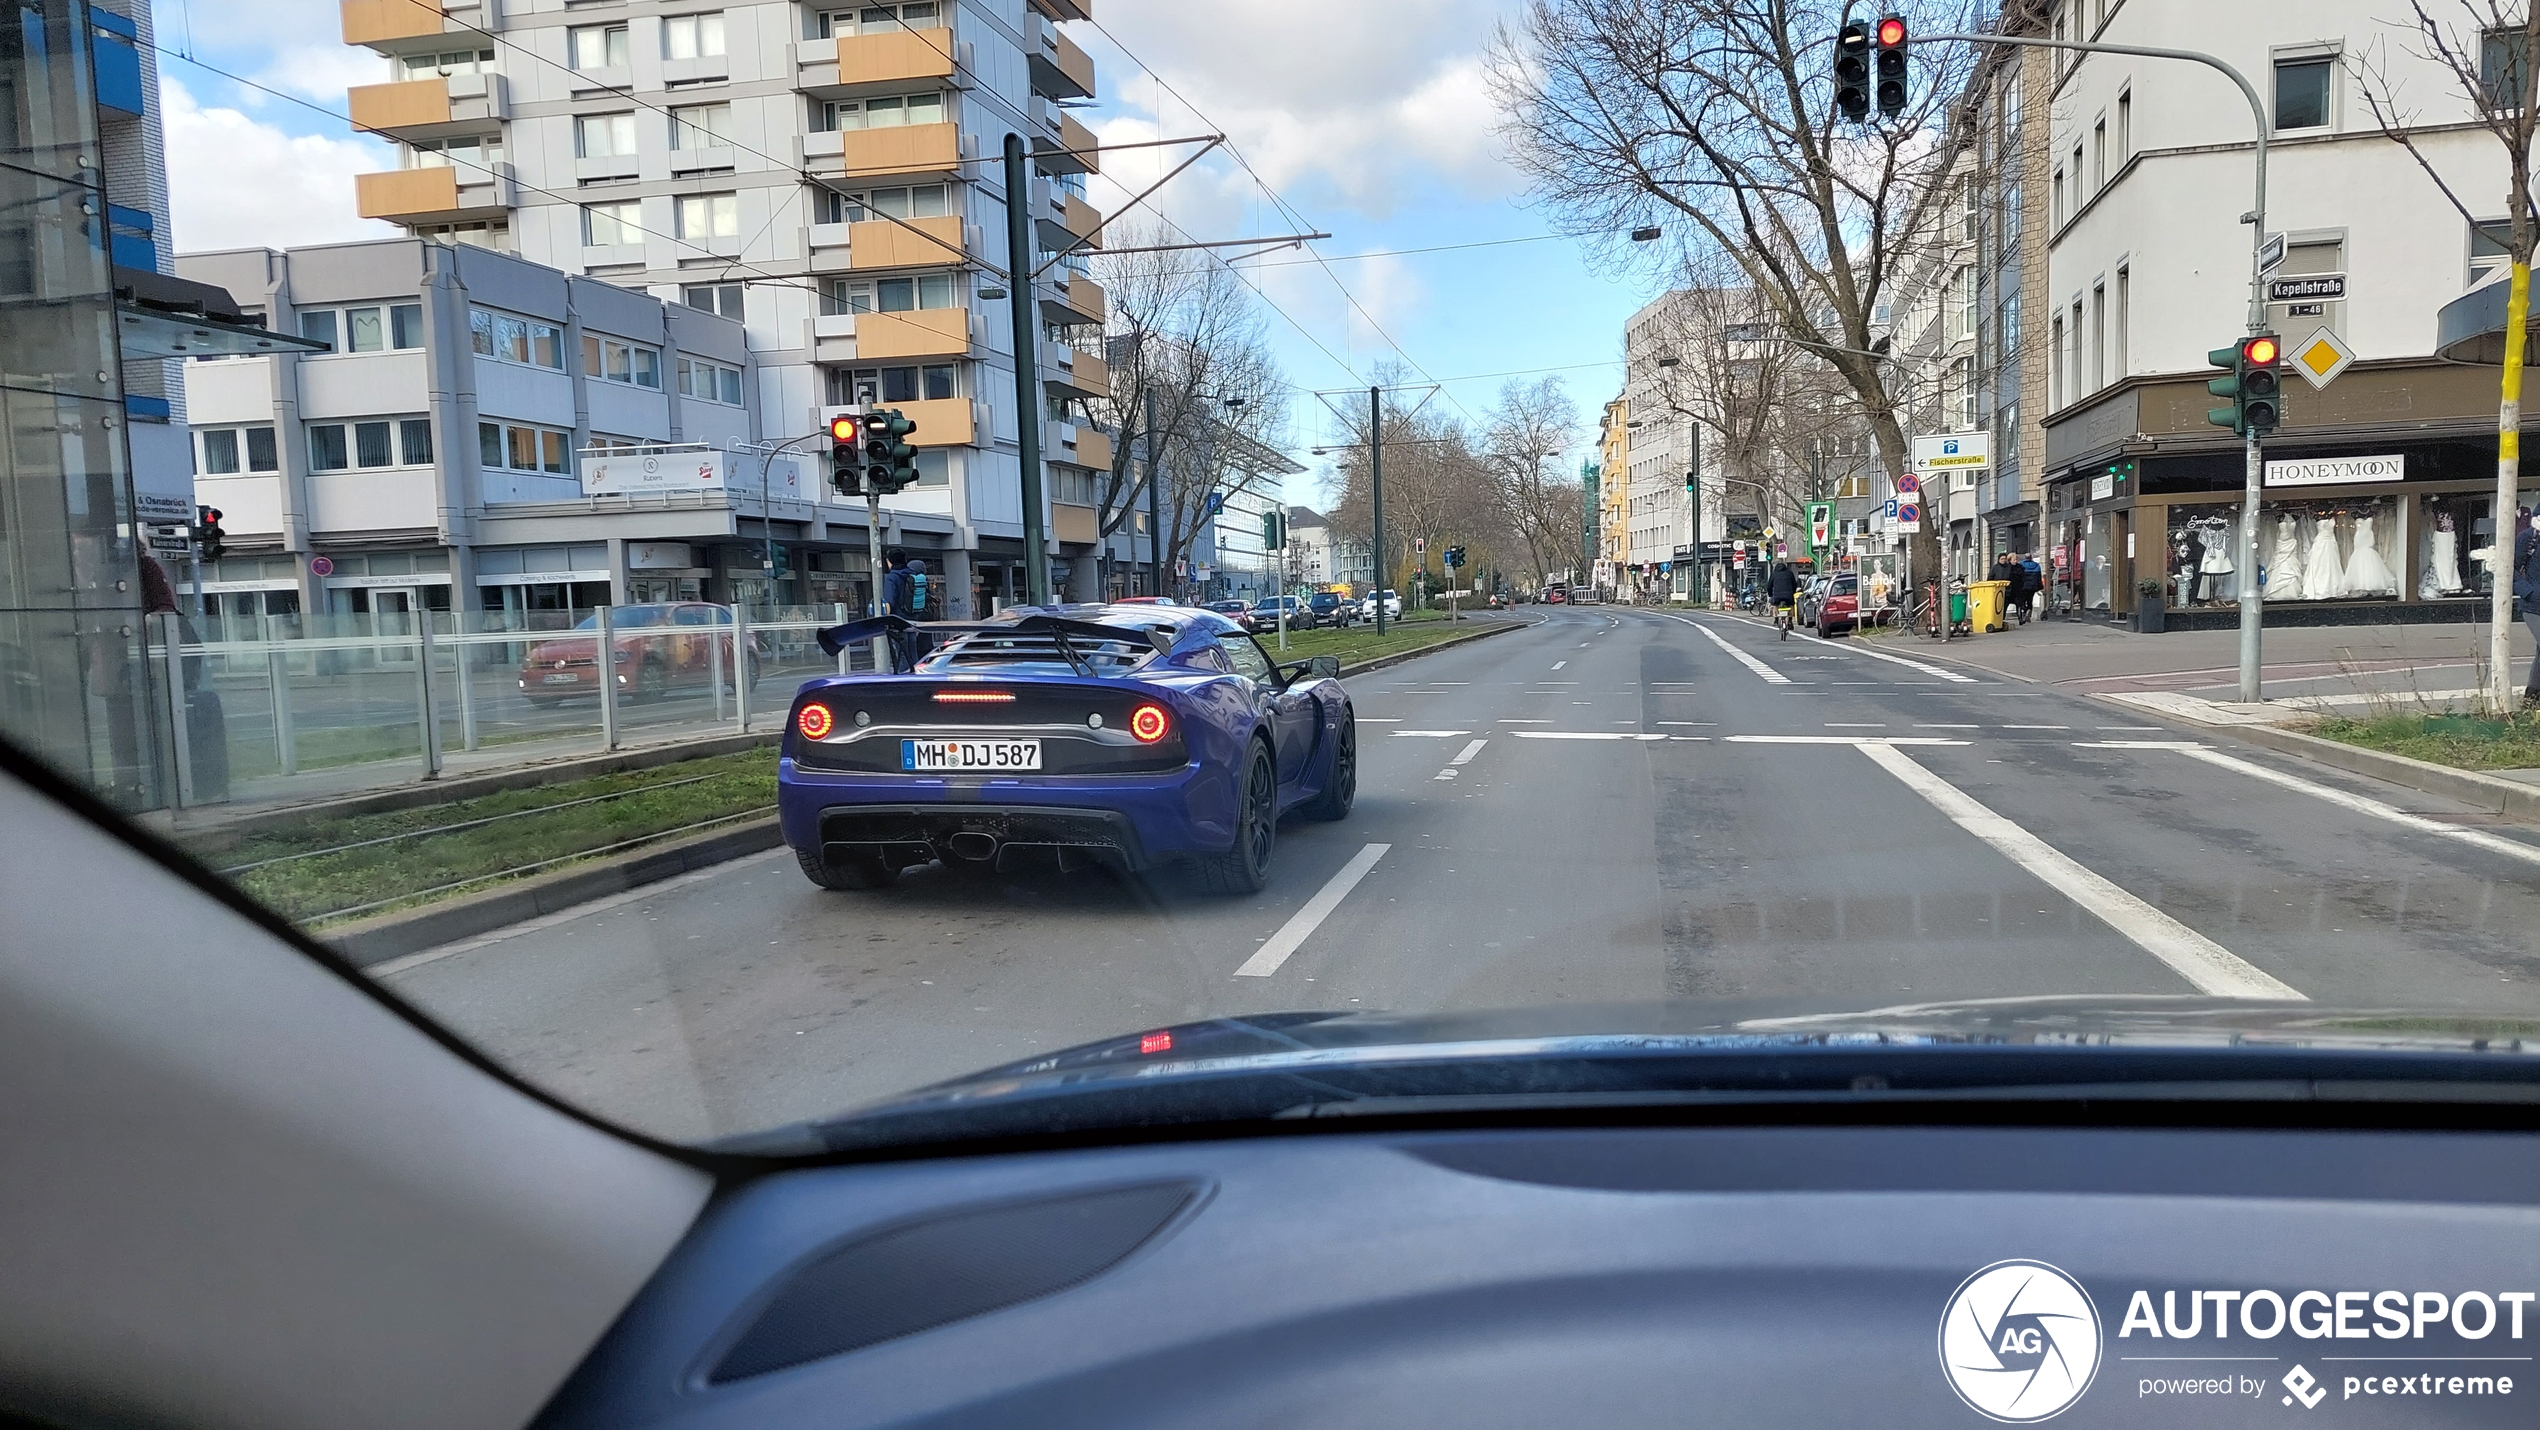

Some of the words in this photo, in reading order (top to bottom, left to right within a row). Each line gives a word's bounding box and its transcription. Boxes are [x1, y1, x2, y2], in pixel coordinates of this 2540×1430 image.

[2274, 279, 2341, 297] Kapellstraße
[1929, 456, 1982, 466] Fischerstraße
[2270, 460, 2399, 480] HONEYMOON
[146, 496, 187, 507] Osnabrück
[917, 744, 946, 766] MH
[962, 744, 990, 766] DJ
[996, 744, 1037, 766] 587
